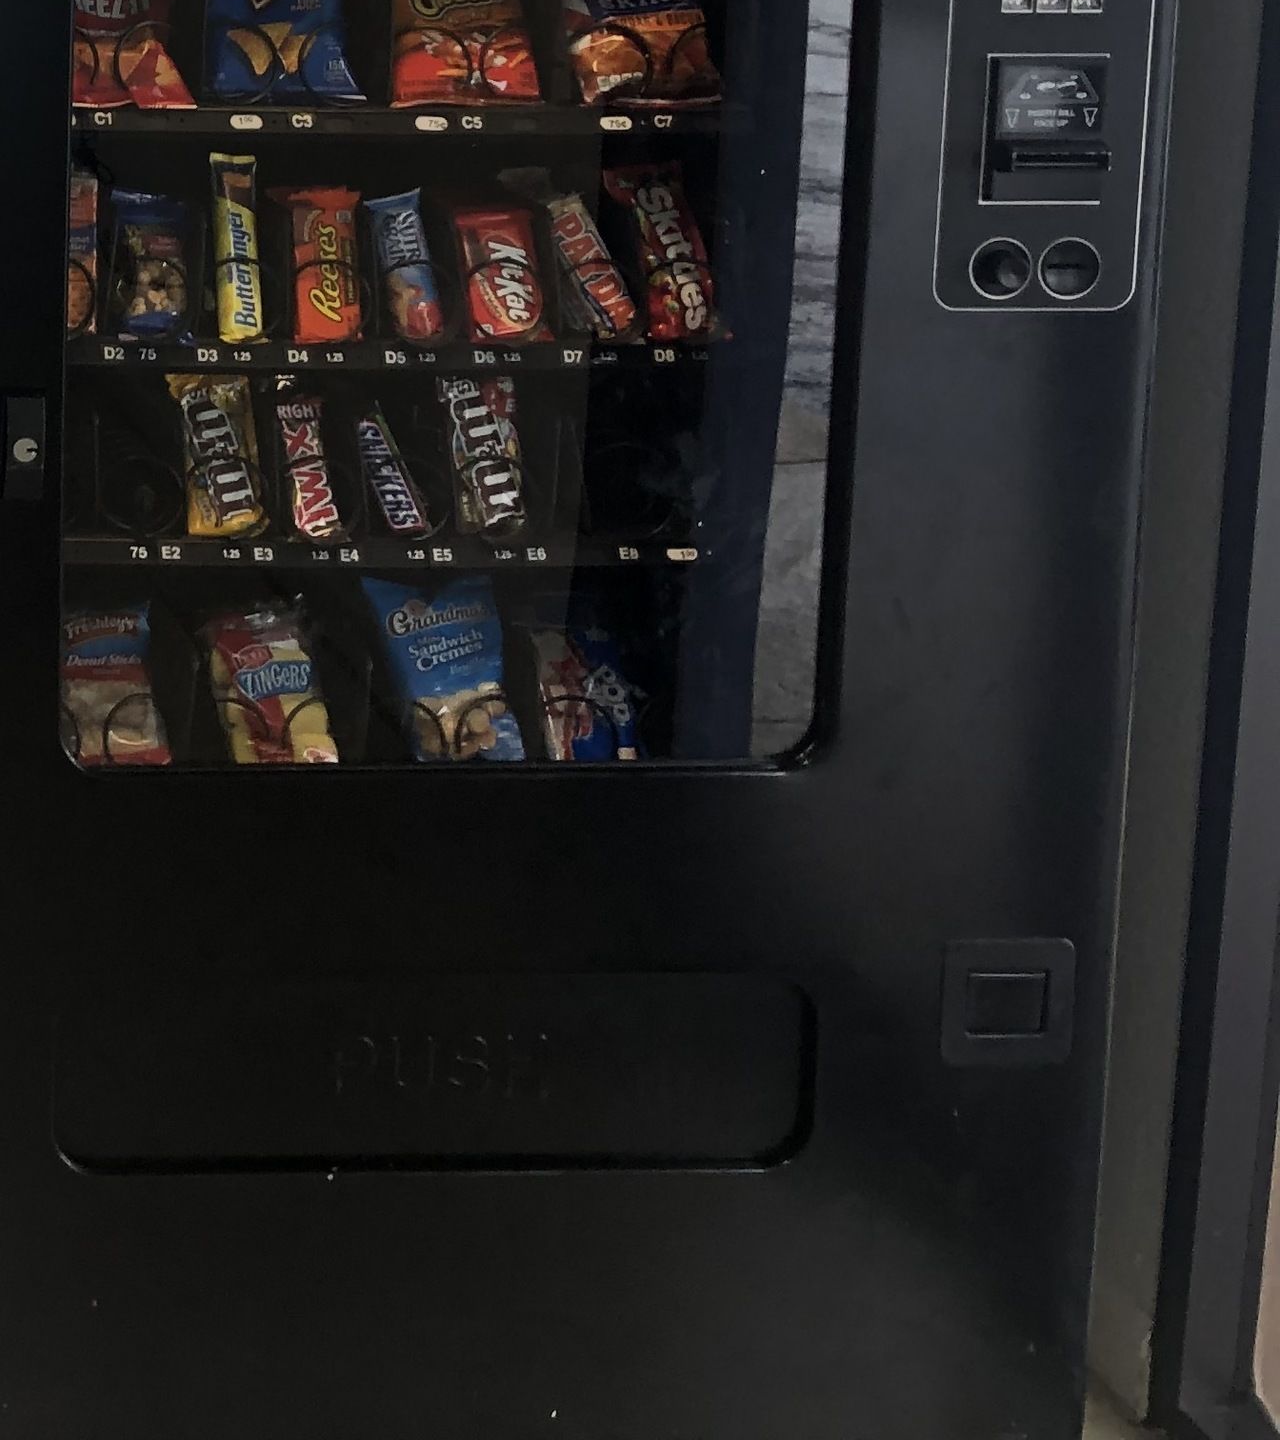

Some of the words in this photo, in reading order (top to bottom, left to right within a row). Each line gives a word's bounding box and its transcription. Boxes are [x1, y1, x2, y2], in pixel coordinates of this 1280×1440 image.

[94, 112, 113, 125] C1
[1058, 109, 1076, 117] BILL
[291, 114, 313, 128] C3
[461, 115, 483, 129] C5
[653, 115, 673, 129] C7
[636, 185, 707, 332] Skittles
[103, 347, 124, 360] D2
[138, 347, 157, 361] 75
[197, 348, 218, 362] D3
[233, 351, 252, 362] 1.25
[287, 349, 308, 363] D4
[325, 351, 345, 363] 1.25
[384, 350, 406, 365] D5
[418, 352, 436, 363] 1.25
[474, 350, 496, 365] D6
[503, 352, 521, 363] 1.25
[563, 349, 583, 364] D7
[653, 348, 675, 363] D8
[277, 404, 321, 420] RIGHT
[359, 424, 421, 527] SNICKERS
[129, 546, 147, 558] 75
[161, 545, 181, 559] E2
[223, 548, 240, 559] 1.25
[254, 547, 273, 561] E3
[311, 550, 329, 561] 1.25
[340, 548, 359, 562] E4
[406, 549, 425, 560] 1.25
[433, 547, 453, 562] E5
[527, 547, 547, 561] E6
[408, 628, 484, 659] Sandwich
[416, 641, 483, 672] Cremes
[334, 1032, 550, 1099] PUSH
